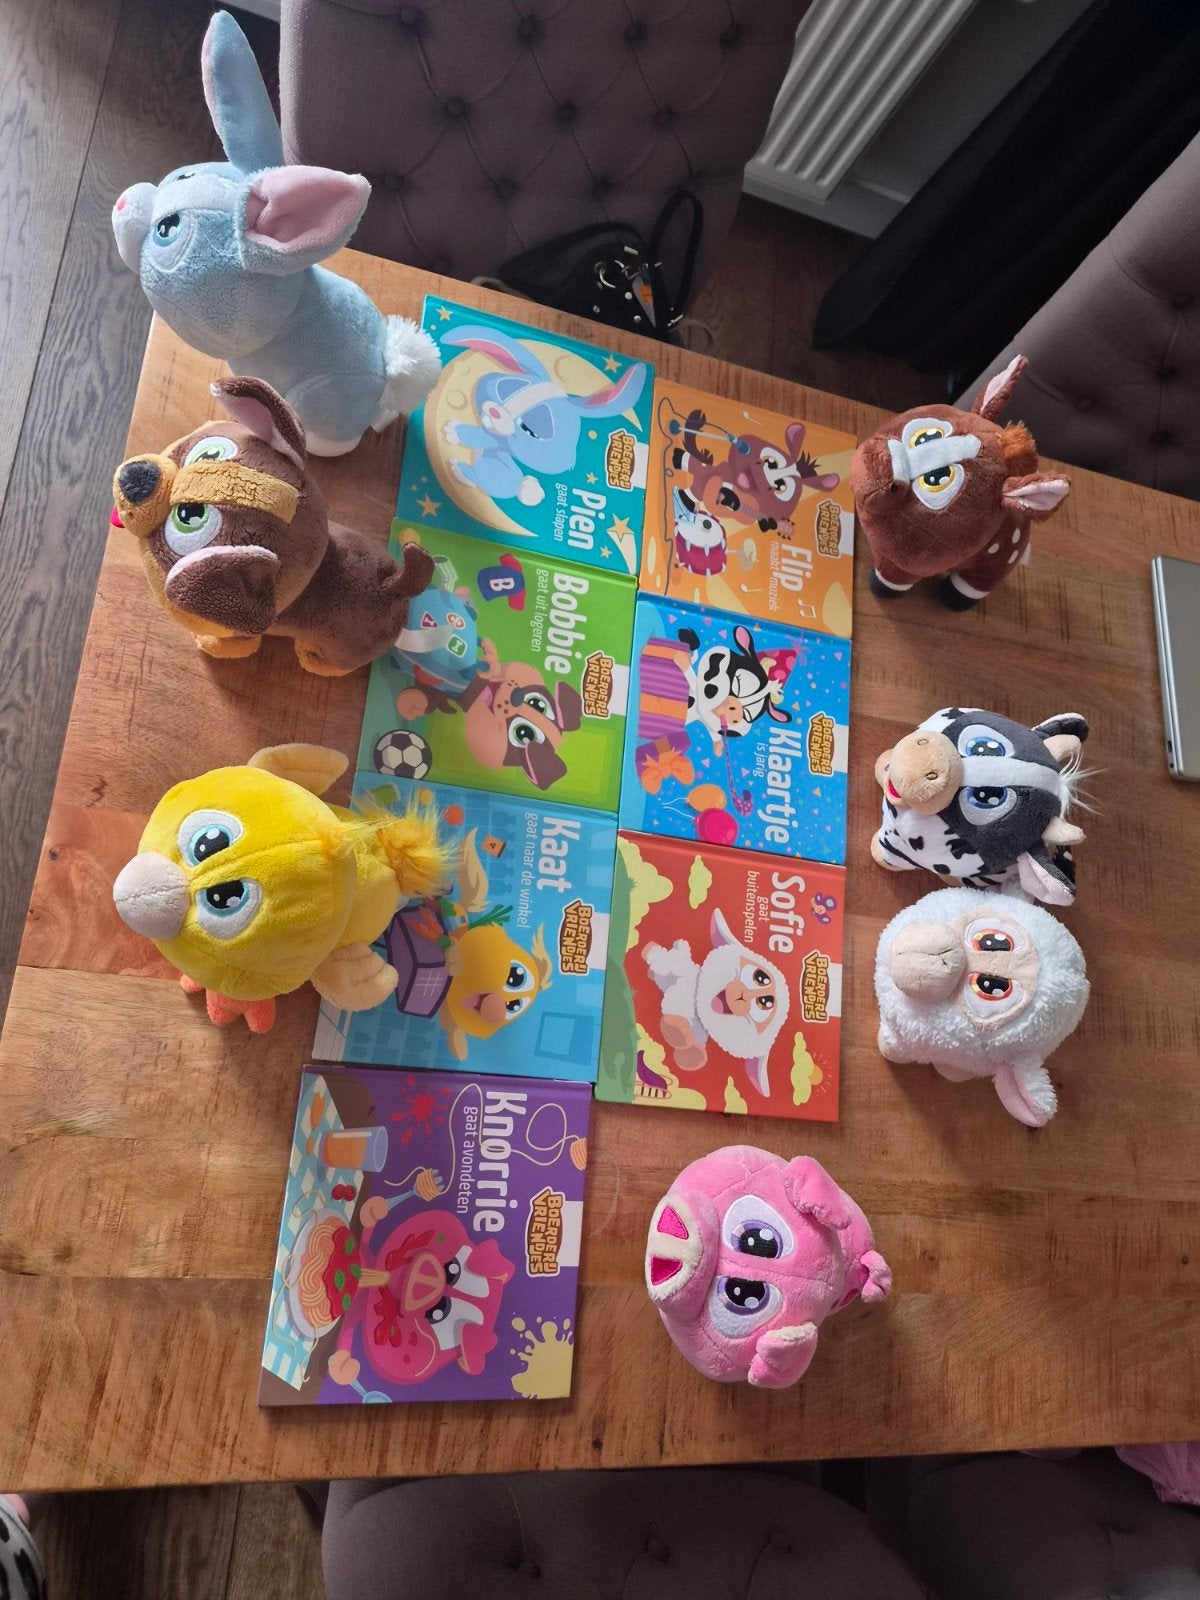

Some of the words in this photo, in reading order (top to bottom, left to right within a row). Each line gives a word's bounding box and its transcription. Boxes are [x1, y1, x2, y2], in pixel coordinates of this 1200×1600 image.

[608, 431, 625, 487] VRIENDJES
[555, 482, 568, 507] gaat
[552, 507, 569, 542] slapen
[567, 488, 607, 550] Pien
[818, 500, 831, 555] VRIENDJES
[769, 541, 781, 572] maakt
[772, 543, 813, 592] Flip
[489, 577, 515, 592] B
[536, 568, 549, 594] gaat
[768, 577, 781, 612] muziek
[535, 595, 550, 614] uit
[544, 572, 590, 674] Bobbie
[530, 613, 549, 652] logeren
[584, 652, 602, 716] VRIENDJES
[752, 752, 769, 778] jarig
[756, 742, 769, 753] is
[810, 713, 825, 773] VRIENDJES
[757, 726, 803, 844] Klaartje
[524, 812, 539, 840] gaat
[523, 841, 535, 868] naar
[536, 816, 582, 894] Kaat
[521, 869, 536, 887] de
[516, 887, 533, 929] winkel
[742, 870, 760, 944] buitenspelen
[756, 896, 769, 922] gaat
[768, 871, 806, 954] Sofie
[560, 899, 582, 973] VRIENDJES
[803, 951, 819, 1021] VRIENDJES
[463, 1106, 479, 1138] gaat
[456, 1139, 479, 1214] avondeten
[472, 1090, 528, 1233] Knorrie
[529, 1189, 551, 1275] VRIENDJES
